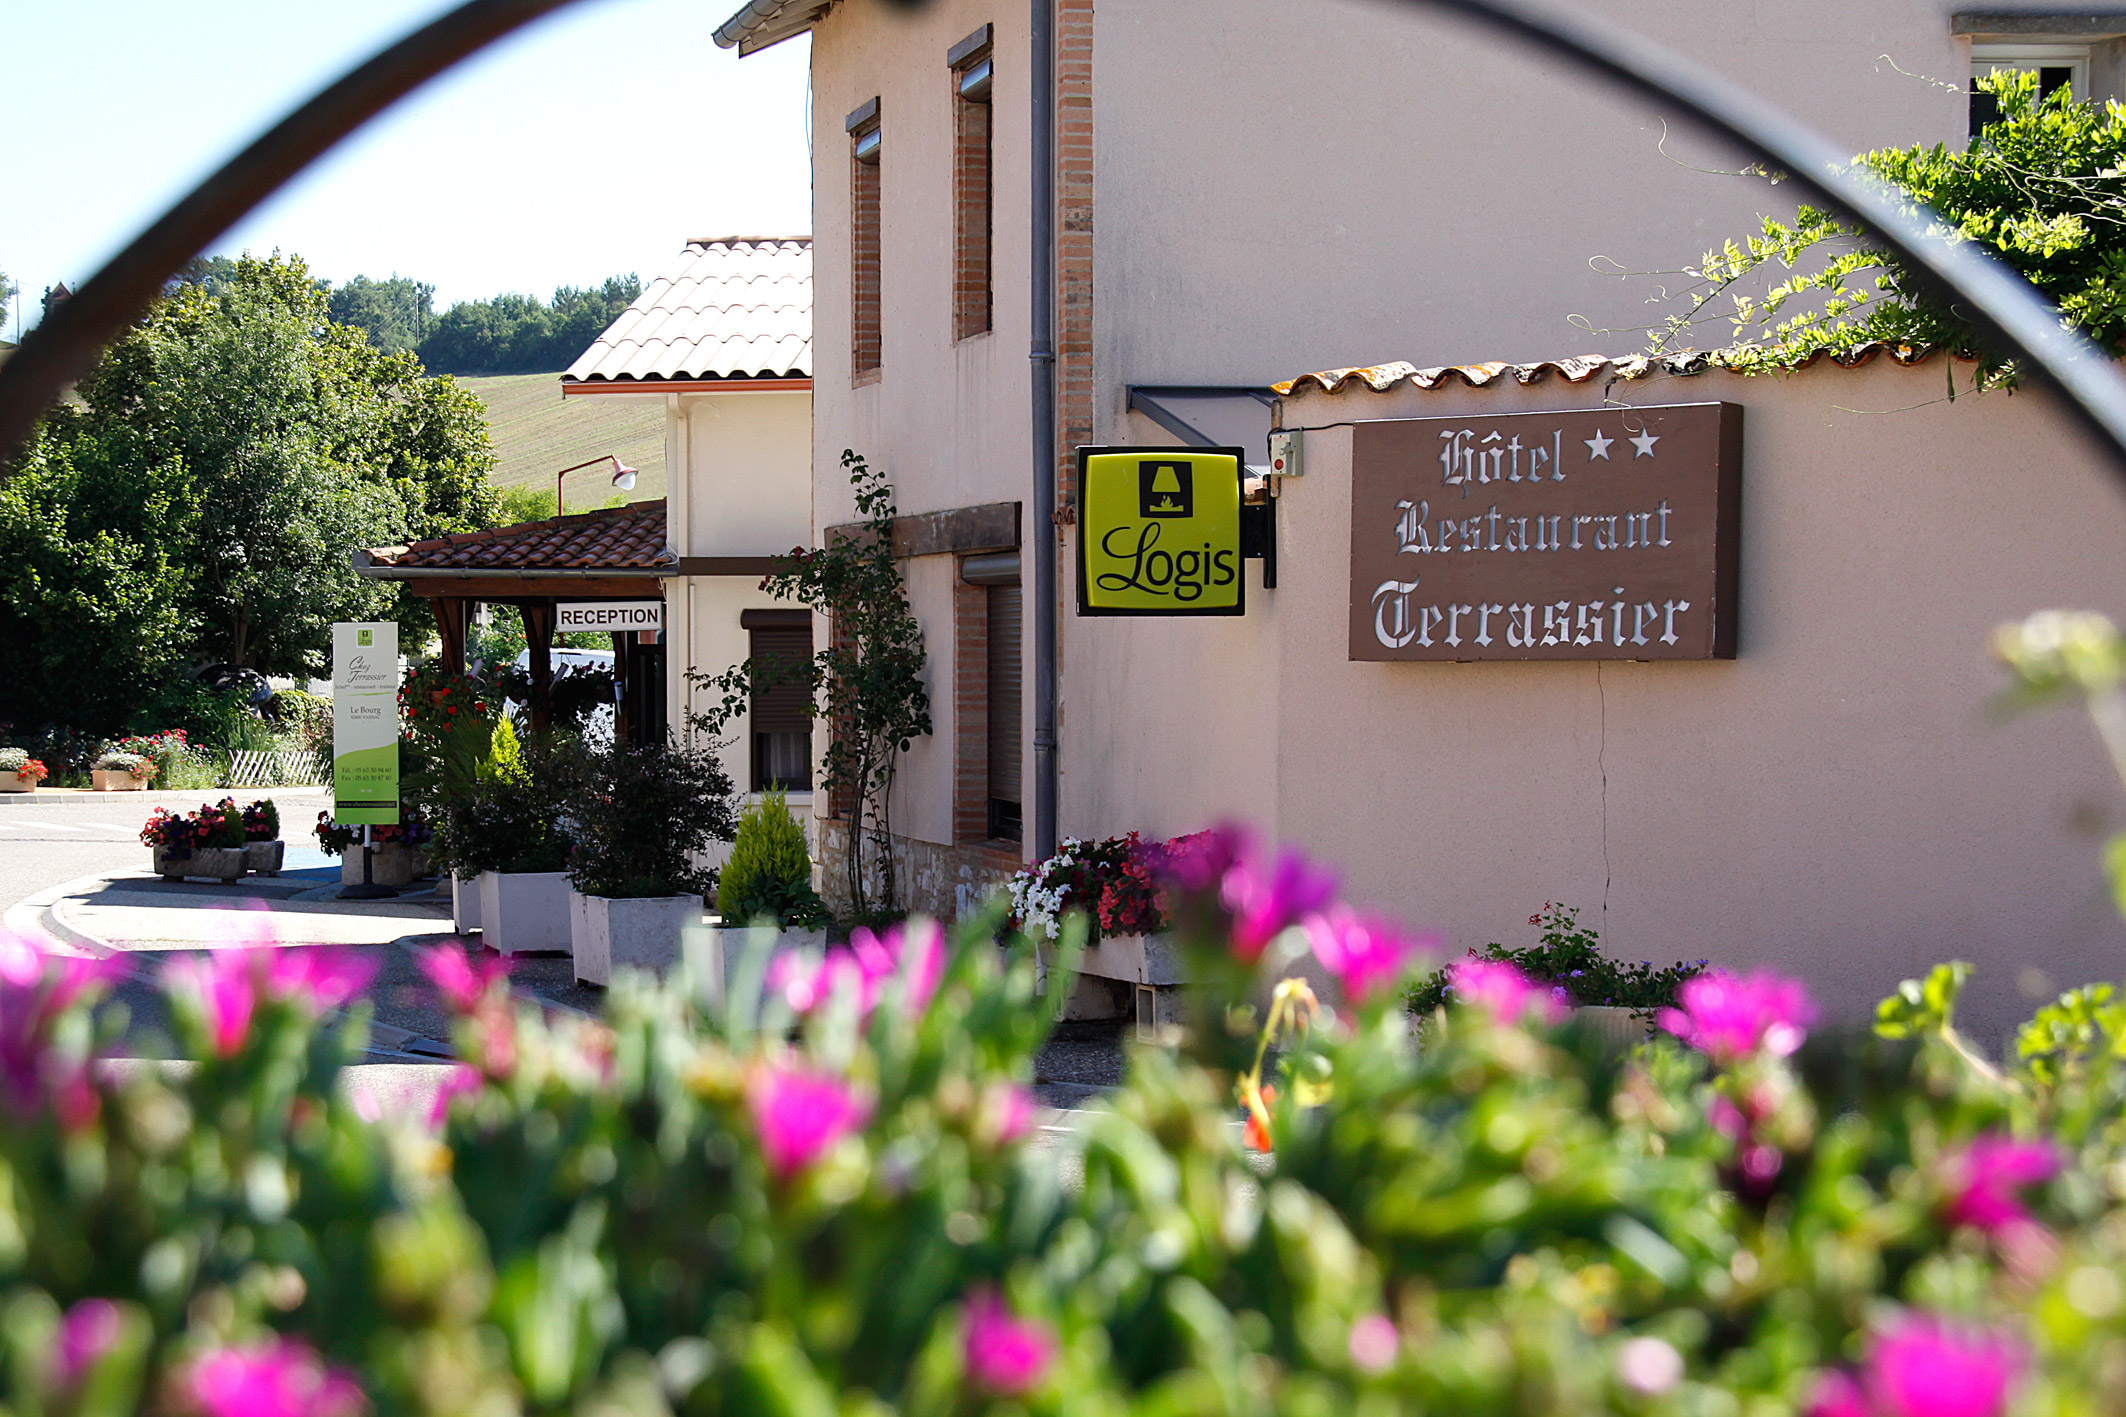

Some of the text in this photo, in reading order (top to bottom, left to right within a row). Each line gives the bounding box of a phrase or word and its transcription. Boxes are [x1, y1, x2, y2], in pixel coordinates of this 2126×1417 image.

[1437, 428, 1566, 499] Hôtel
[1394, 497, 1672, 555] Restaurant
[1096, 521, 1235, 601] Logis
[561, 608, 658, 624] RECEPTION
[1370, 573, 1690, 649] Terrassier
[347, 670, 388, 683] Terrassier
[348, 655, 371, 673] Chez
[350, 706, 382, 715] Le Bourg
